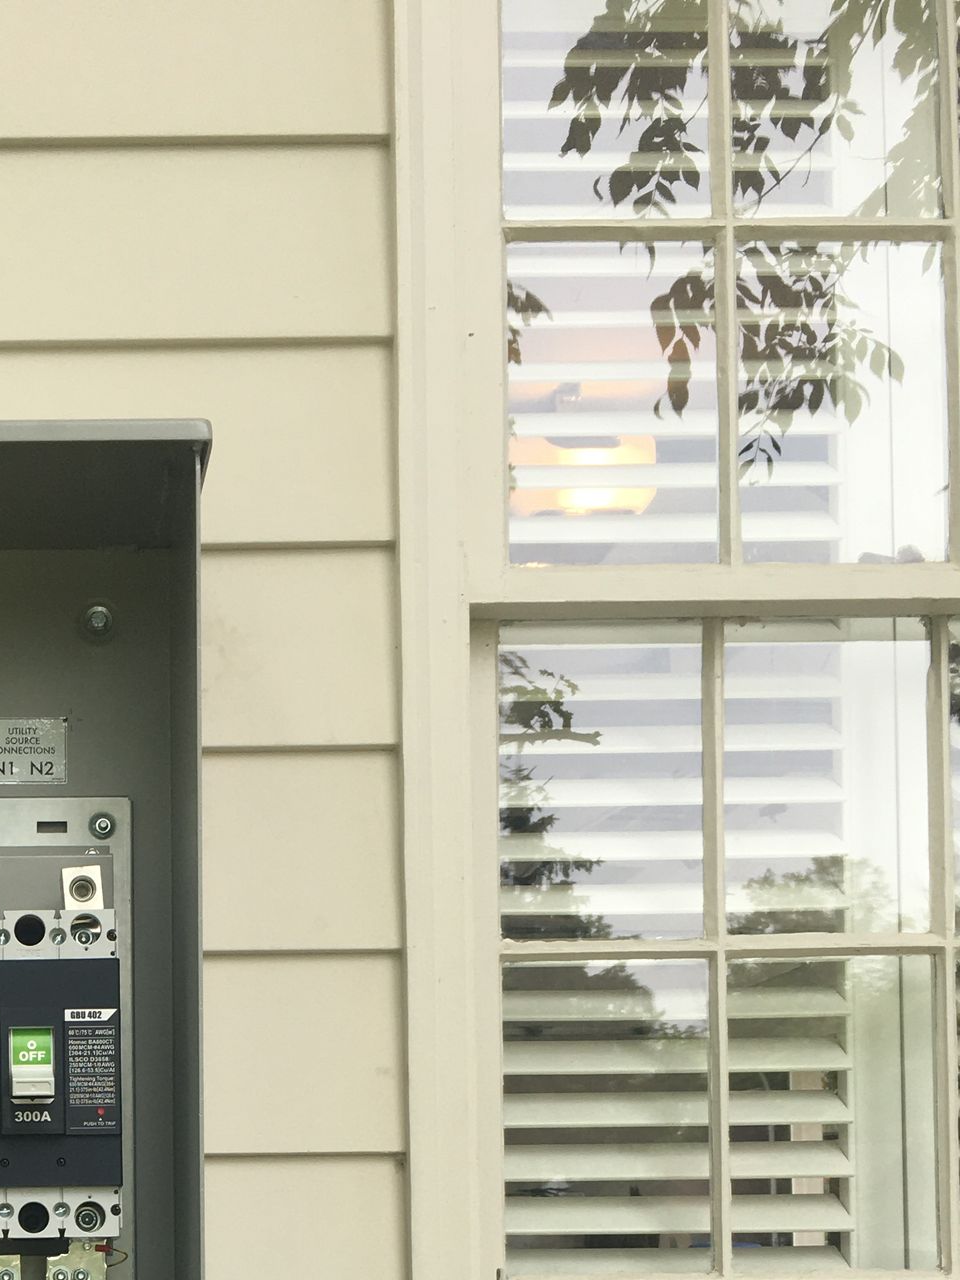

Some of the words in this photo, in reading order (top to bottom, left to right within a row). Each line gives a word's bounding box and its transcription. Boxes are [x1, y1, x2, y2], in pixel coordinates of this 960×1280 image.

[8, 727, 37, 735] UTILITY
[5, 737, 40, 745] SOURCE
[30, 761, 54, 775] N2
[70, 1011, 86, 1019] GBU
[87, 1011, 102, 1019] 402
[19, 1051, 46, 1061] OFF
[14, 1111, 51, 1122] 300A
